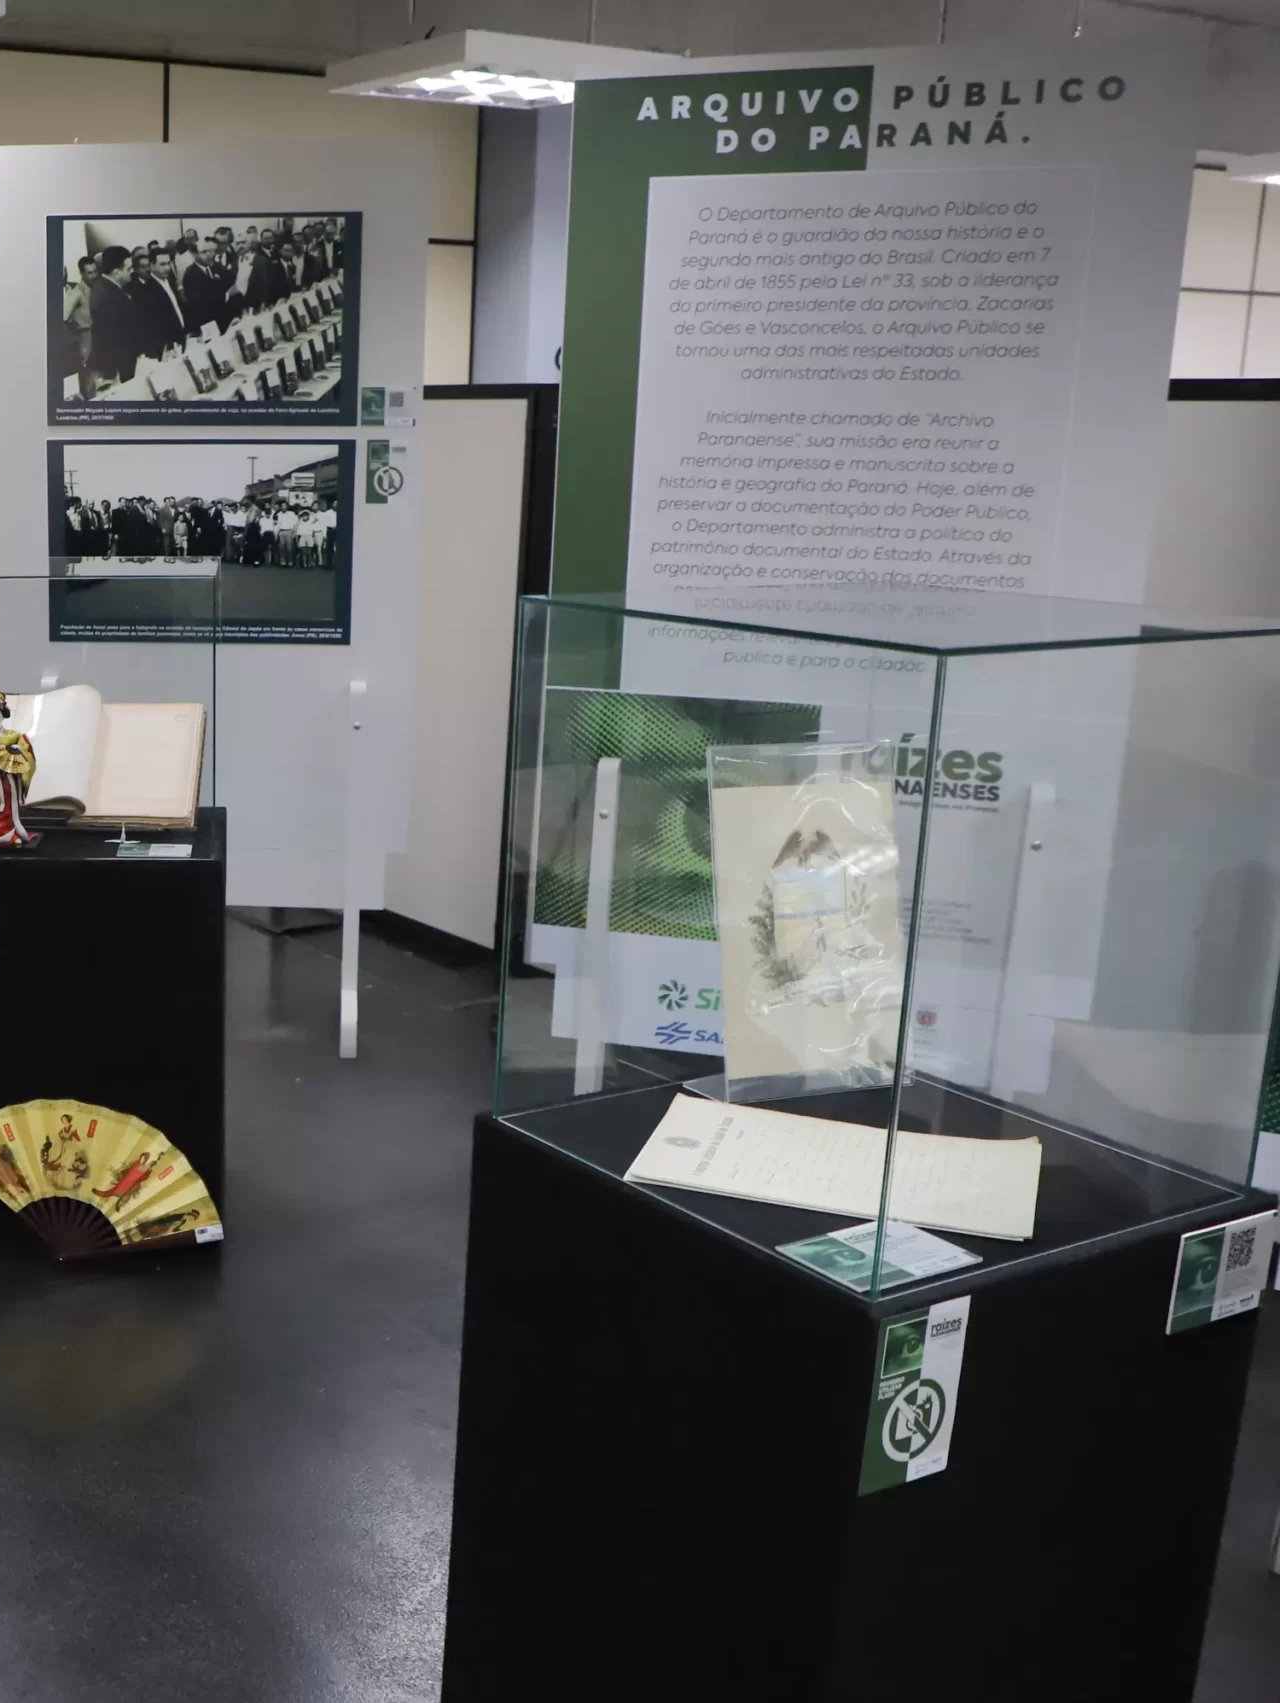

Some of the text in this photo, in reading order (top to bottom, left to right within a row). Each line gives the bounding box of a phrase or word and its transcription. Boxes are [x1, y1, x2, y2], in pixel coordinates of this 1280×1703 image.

[636, 75, 1127, 123] ARQUIVO PÚBLICO
[716, 111, 1031, 154] DO PARANÁ.
[697, 200, 1039, 224] O Departamento de Arquivo Público do
[688, 225, 1045, 247] Paraná é o guardião da nossa história e o
[680, 253, 752, 271] segundo
[755, 253, 795, 266] mais
[798, 252, 856, 270] antigo
[858, 251, 883, 265] do
[940, 248, 1003, 264] Criado
[1005, 251, 1036, 263] em
[1042, 247, 1052, 261] 7
[668, 276, 691, 291] de
[693, 276, 731, 291] abril
[734, 275, 757, 290] de
[761, 273, 797, 289] 1855
[799, 275, 839, 292] pela
[841, 275, 868, 289] Lei
[921, 273, 954, 288] sob
[957, 275, 970, 288] a
[669, 299, 692, 314] do
[694, 299, 764, 315] primeiro
[766, 298, 857, 314] presidente
[859, 296, 885, 312] da
[673, 321, 696, 335] de
[744, 323, 757, 335] e
[871, 323, 885, 335] o
[886, 320, 954, 337] Arquivo
[956, 319, 1022, 335] Público
[1025, 322, 1046, 335] se
[675, 344, 1040, 359] tornou uma das mais respeitadas unidades
[740, 366, 869, 381] administrativas
[871, 367, 896, 381] do
[705, 410, 807, 426] Inicialmente
[809, 411, 894, 427] chamado
[896, 412, 921, 427] de
[806, 436, 836, 448] sua
[839, 434, 899, 449] missão
[901, 437, 931, 450] era
[934, 438, 985, 451] reunir
[986, 439, 1000, 452] a
[679, 455, 1015, 475] memória impressa e manuscrita sobre a
[658, 475, 718, 490] história
[720, 478, 732, 490] e
[734, 477, 817, 495] geografia
[820, 478, 844, 493] do
[962, 482, 1008, 497] além
[1011, 483, 1036, 498] de
[656, 499, 733, 513] preservar
[735, 501, 747, 513] a
[750, 500, 881, 519] documentação
[883, 503, 908, 517] do
[911, 502, 962, 518] Poder
[671, 517, 1014, 543] o Departamento administra a política do
[742, 542, 844, 559] documental
[846, 547, 869, 560] do
[938, 549, 1003, 565] Através
[1007, 552, 1032, 567] da
[653, 562, 753, 580] organização
[757, 567, 768, 578] e
